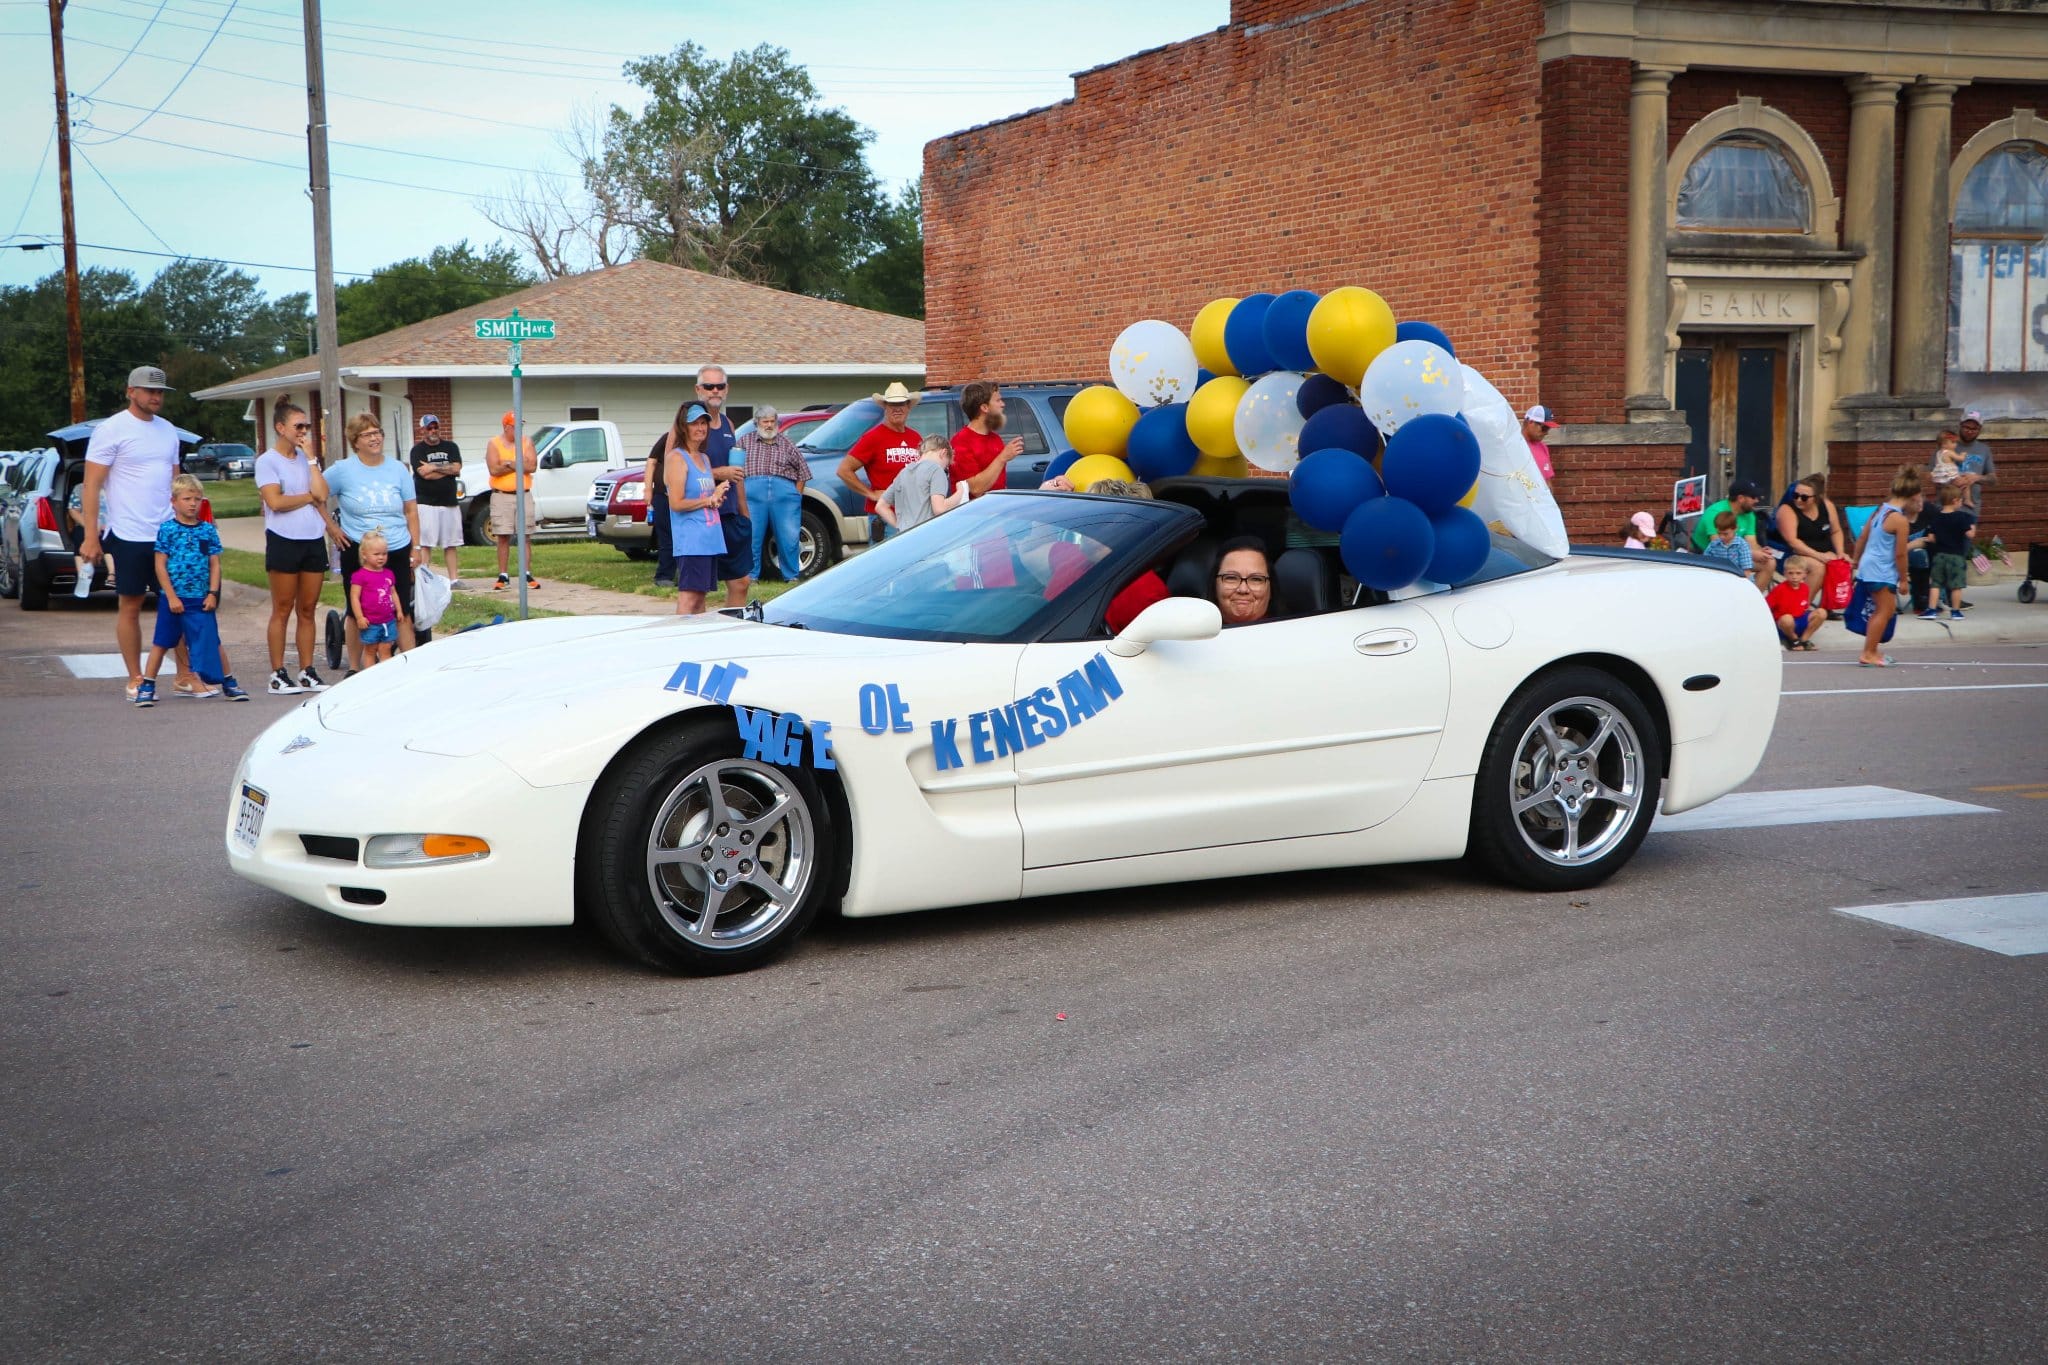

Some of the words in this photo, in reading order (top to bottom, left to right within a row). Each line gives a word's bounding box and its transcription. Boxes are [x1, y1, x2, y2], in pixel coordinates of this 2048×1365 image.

[1699, 292, 1793, 318] BANK
[481, 321, 531, 337] SMITH
[886, 447, 921, 456] NEBRASK
[931, 652, 1124, 771] KENESAW
